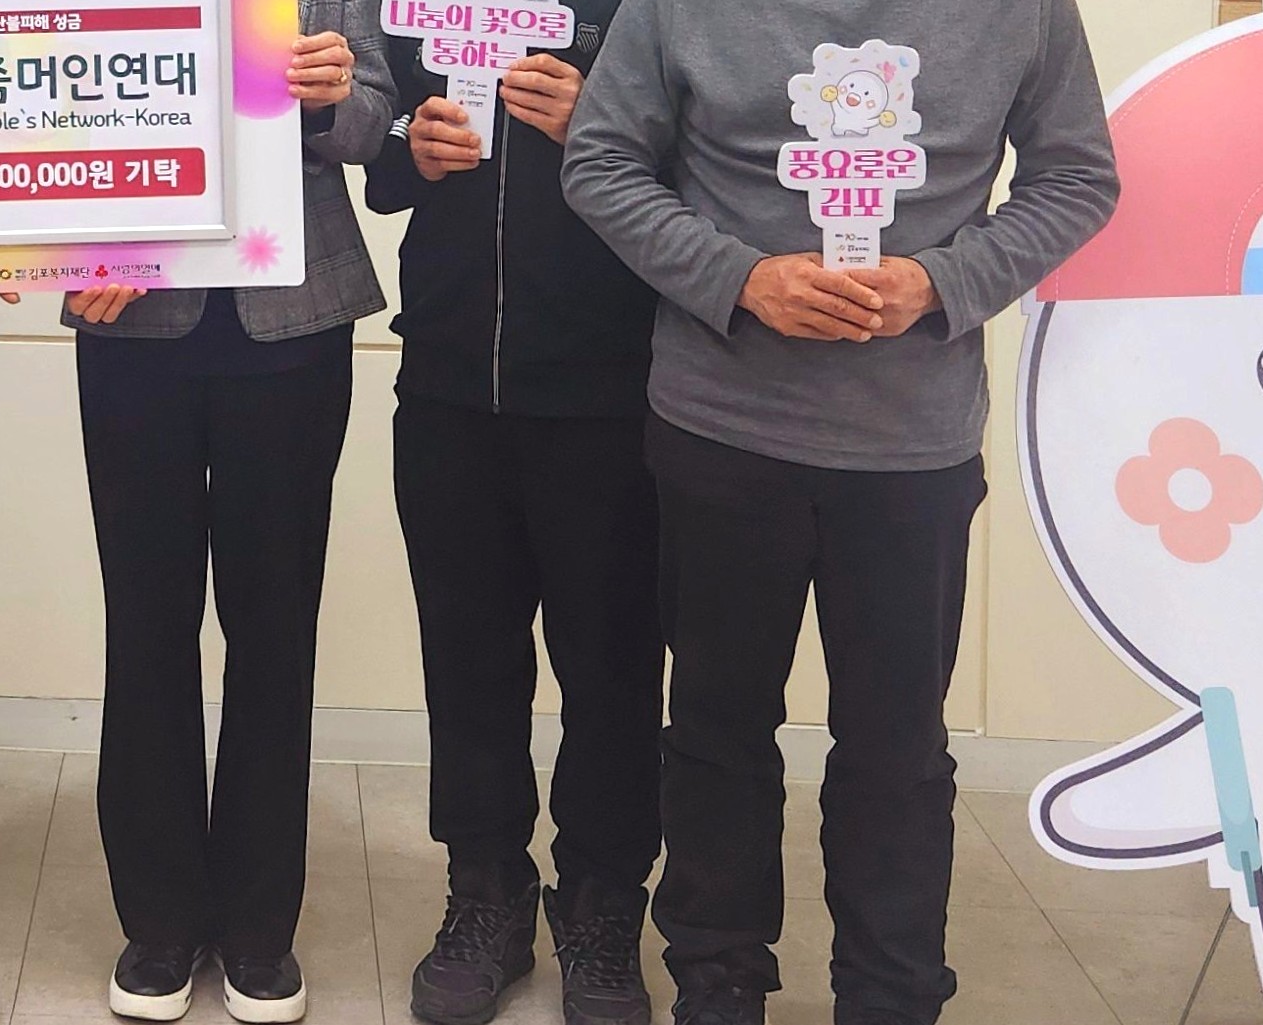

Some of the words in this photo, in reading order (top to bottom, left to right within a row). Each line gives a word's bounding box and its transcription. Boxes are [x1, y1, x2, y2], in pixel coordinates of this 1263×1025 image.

[53, 13, 82, 31] 성금
[390, 0, 473, 32] 나눔의
[481, 7, 567, 39] 꽃으로
[432, 38, 518, 70] 통하는
[42, 108, 192, 128] Network-Korea
[125, 158, 181, 187] 기탁
[789, 149, 917, 179] 풍요로운
[821, 188, 884, 217] 김포
